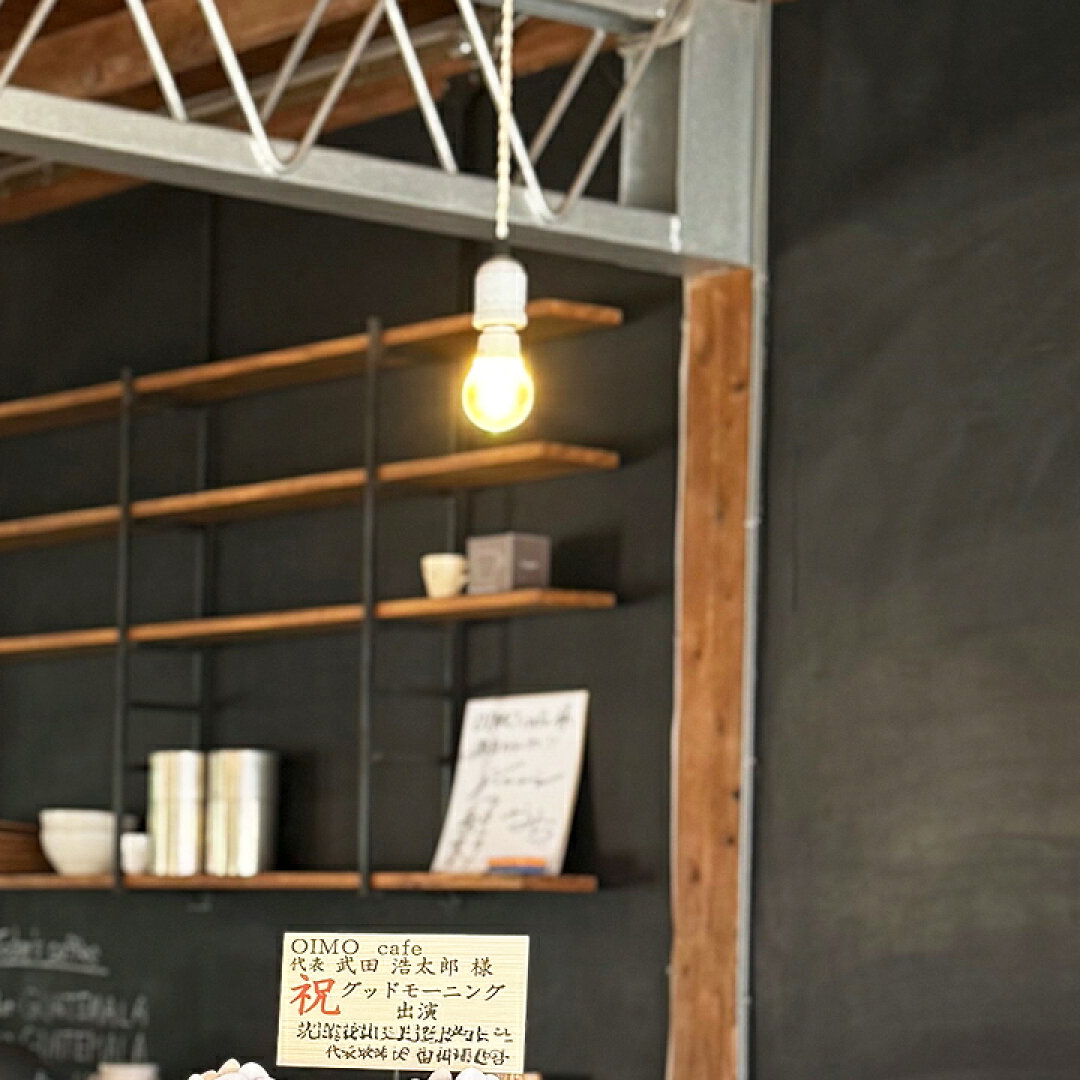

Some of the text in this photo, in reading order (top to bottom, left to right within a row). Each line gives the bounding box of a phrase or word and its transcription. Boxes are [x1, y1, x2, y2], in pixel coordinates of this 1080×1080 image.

[290, 938, 423, 955] OIMO cafe
[290, 956, 494, 977] 代表 武田 浩太郎 様
[289, 973, 506, 1016] 祝 グッドモーニング
[396, 1001, 439, 1021] 出演
